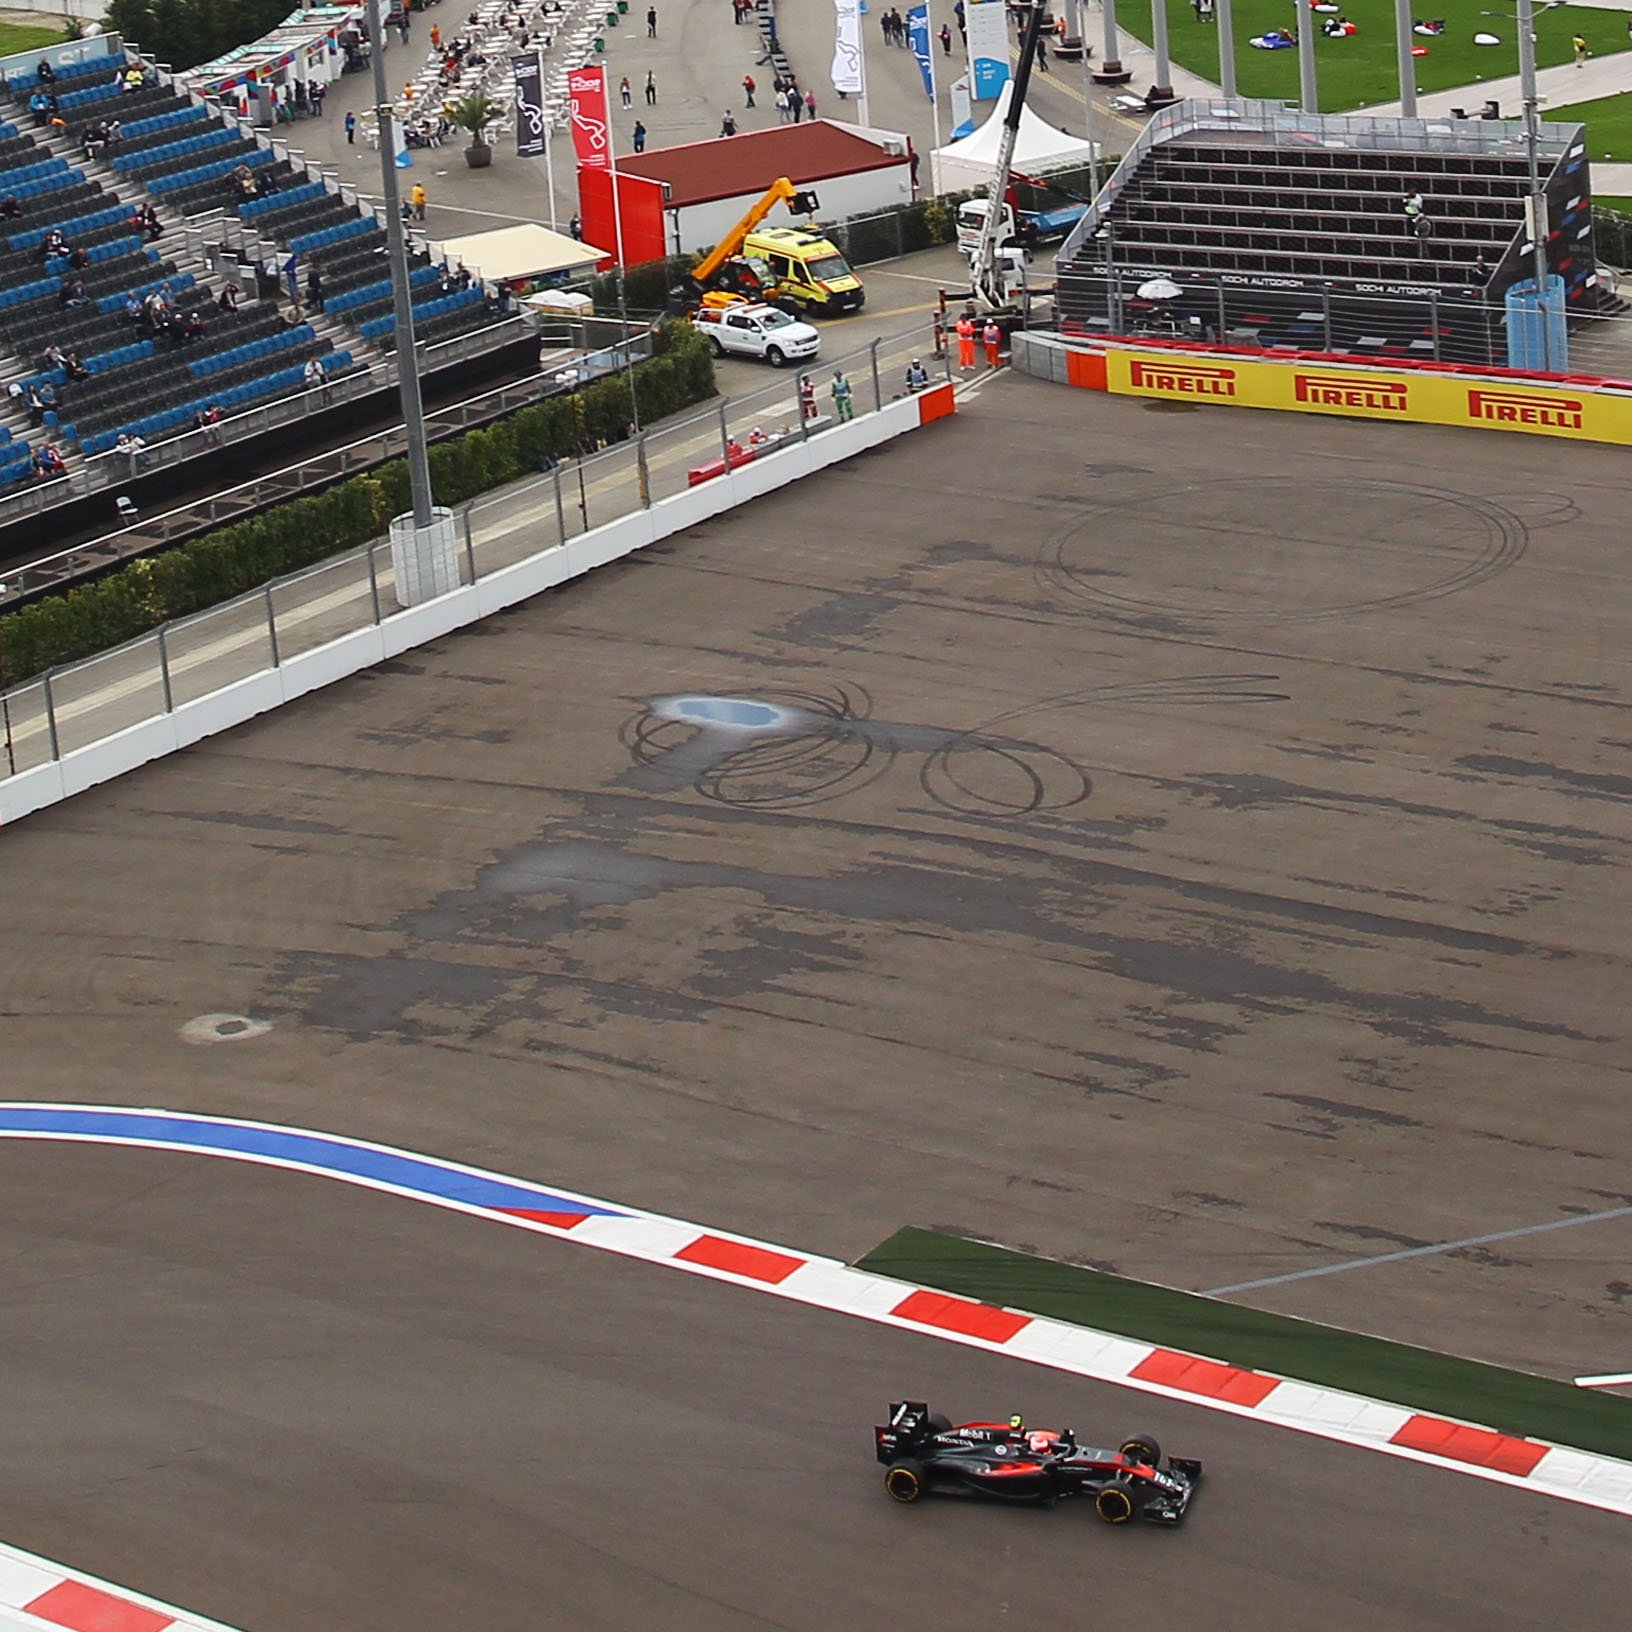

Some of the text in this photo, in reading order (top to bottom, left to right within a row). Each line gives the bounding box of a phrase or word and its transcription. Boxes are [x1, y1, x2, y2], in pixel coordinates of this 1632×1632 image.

[1122, 269, 1172, 279] AUTODROM
[1221, 275, 1304, 287] SOCHI AUTODROM
[1355, 283, 1442, 296] SOCHI AUTODROM
[1130, 361, 1235, 396] PIRELLI
[1294, 375, 1407, 410] PIRELLI
[1468, 390, 1582, 429] PIRELLI
[937, 1436, 974, 1448] HONDA
